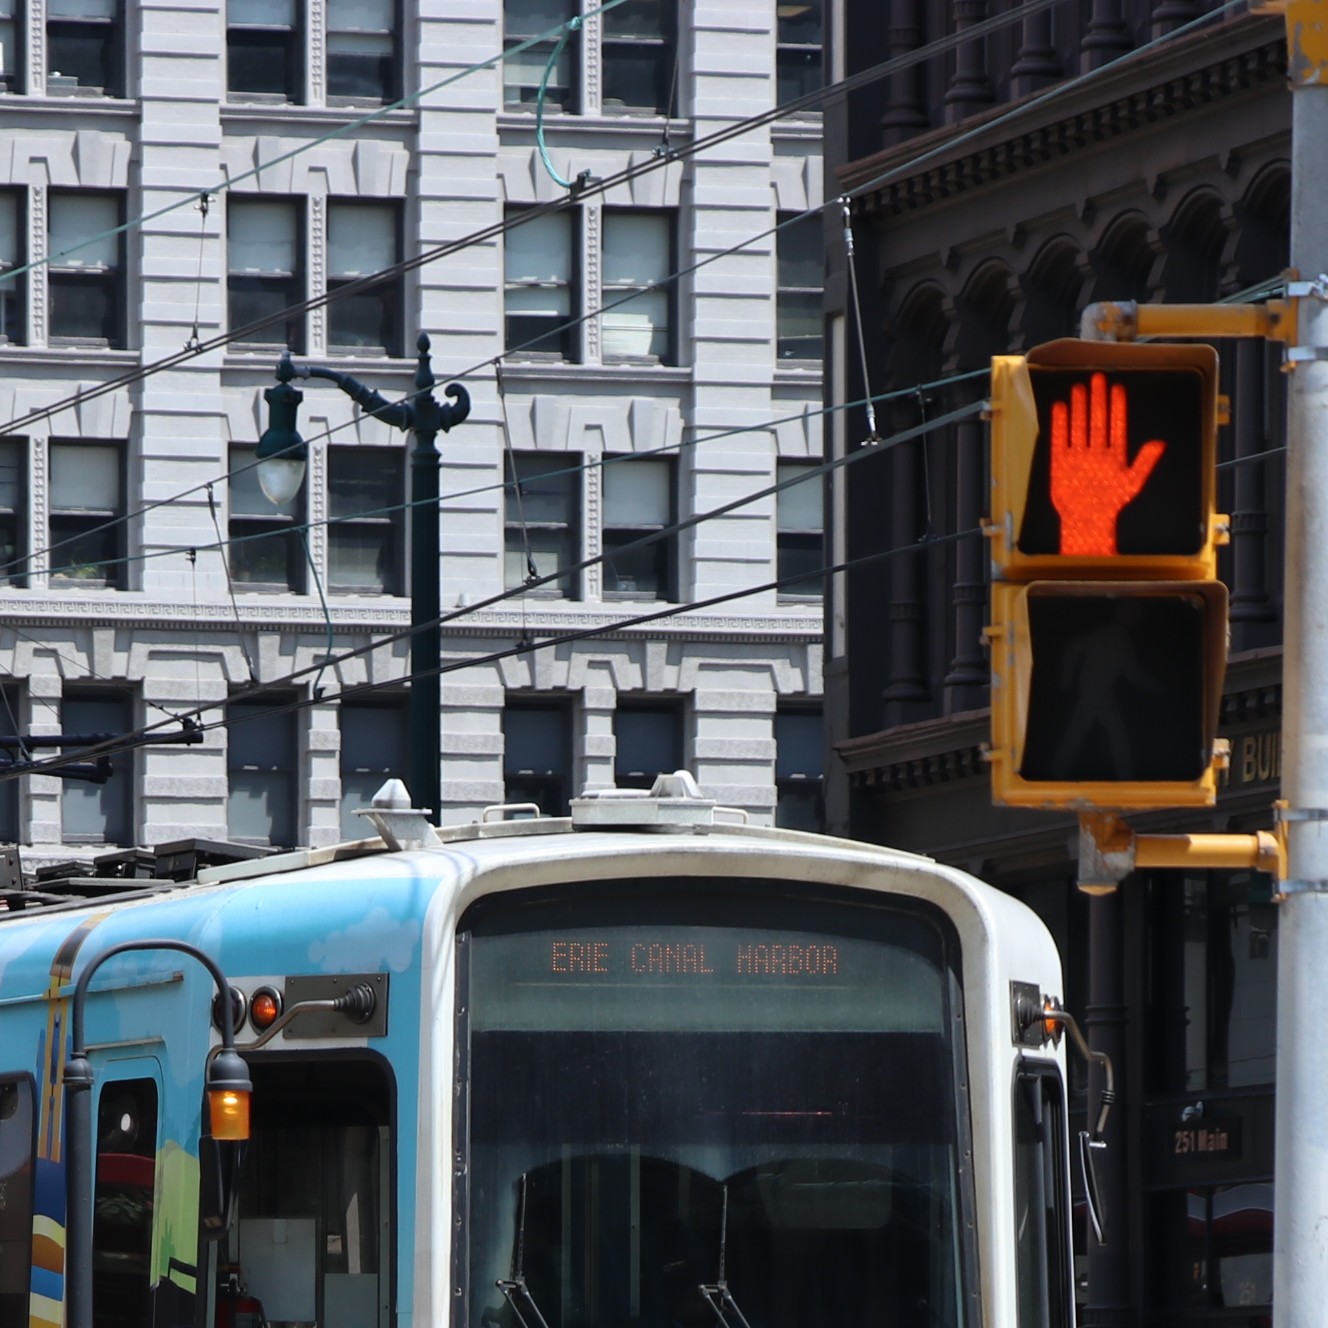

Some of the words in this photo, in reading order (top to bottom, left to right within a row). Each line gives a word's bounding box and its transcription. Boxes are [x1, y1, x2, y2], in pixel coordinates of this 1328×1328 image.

[552, 942, 608, 972] ERIE
[632, 943, 715, 973] CANAL
[737, 944, 838, 974] HARBOR
[1175, 1130, 1195, 1153] 251
[1197, 1127, 1228, 1151] Main
